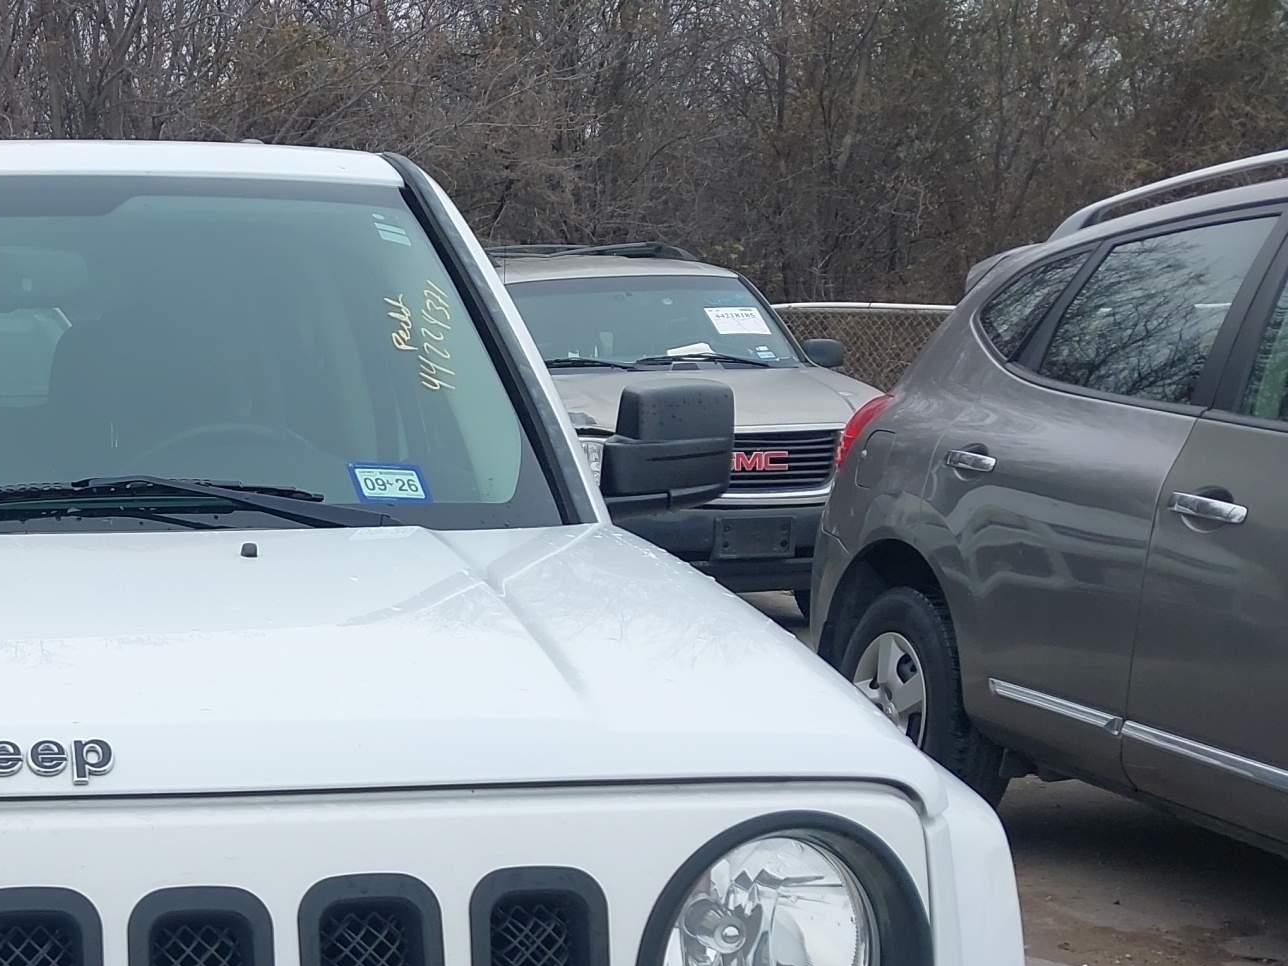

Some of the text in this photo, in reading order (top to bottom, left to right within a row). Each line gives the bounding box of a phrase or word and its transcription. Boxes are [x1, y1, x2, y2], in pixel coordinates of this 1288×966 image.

[418, 280, 456, 390] 44224371
[731, 450, 789, 471] MC
[363, 477, 419, 492] 09 26
